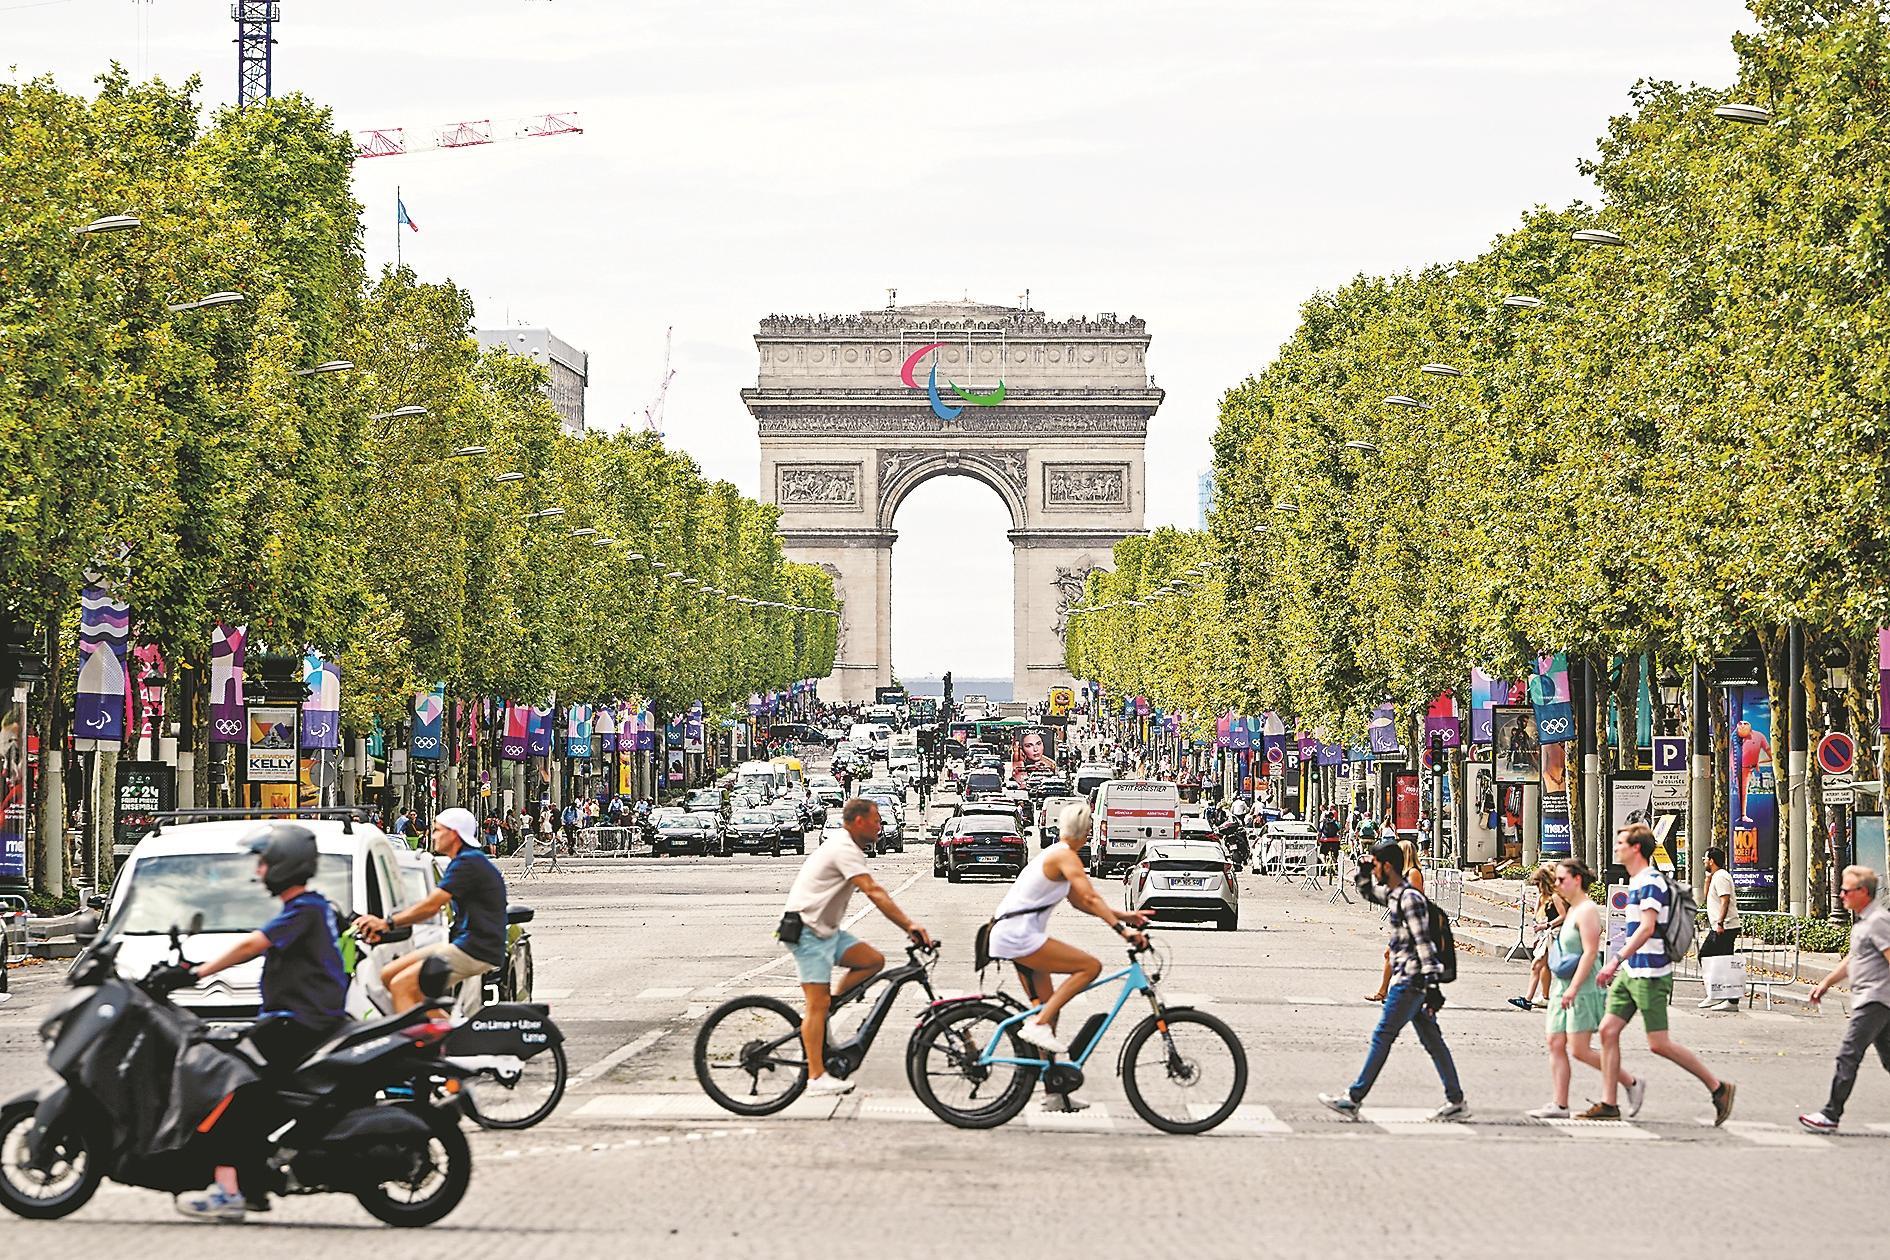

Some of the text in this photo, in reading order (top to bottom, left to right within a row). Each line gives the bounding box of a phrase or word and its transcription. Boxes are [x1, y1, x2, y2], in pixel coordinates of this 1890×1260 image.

[1663, 744, 1678, 766] P
[250, 759, 294, 768] KELLY
[522, 1032, 547, 1044] Lime
